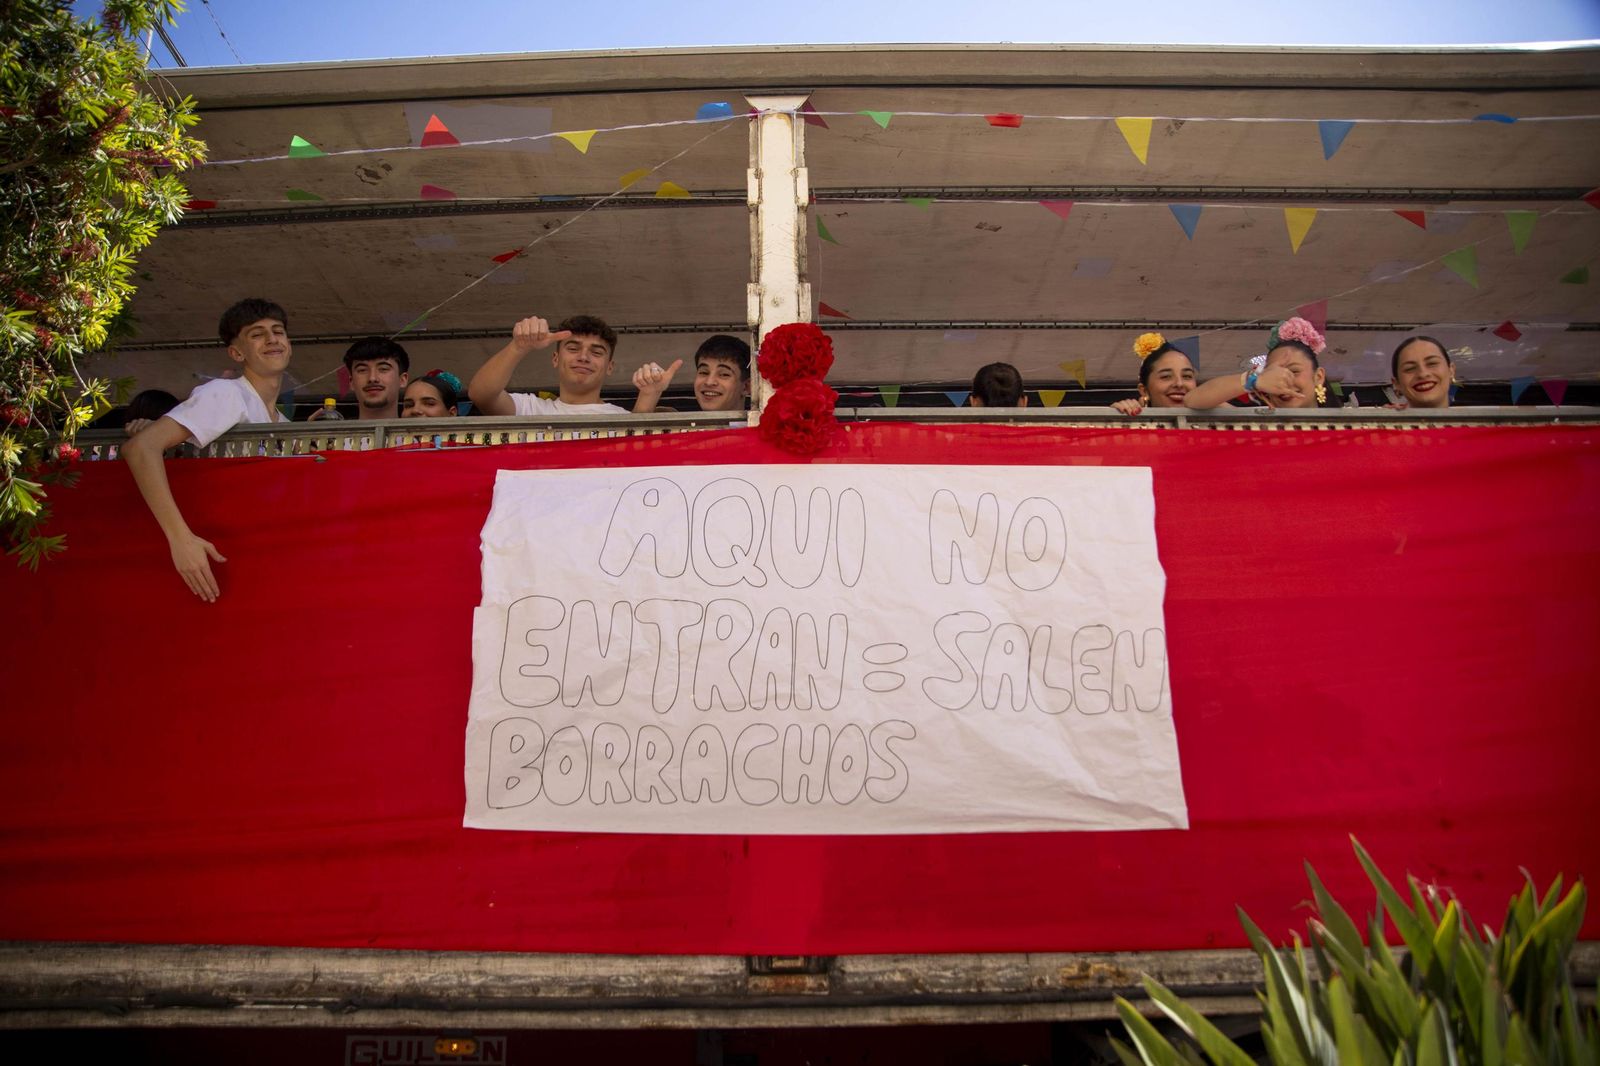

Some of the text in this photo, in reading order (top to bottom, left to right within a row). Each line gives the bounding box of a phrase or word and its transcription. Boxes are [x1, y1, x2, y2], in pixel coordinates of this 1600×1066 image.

[599, 477, 1067, 591] AQUI NO
[500, 595, 848, 714] ENTRAN
[922, 611, 1166, 715] SALEN
[487, 717, 916, 809] BORRACHOS
[351, 1040, 503, 1065] GUILN
